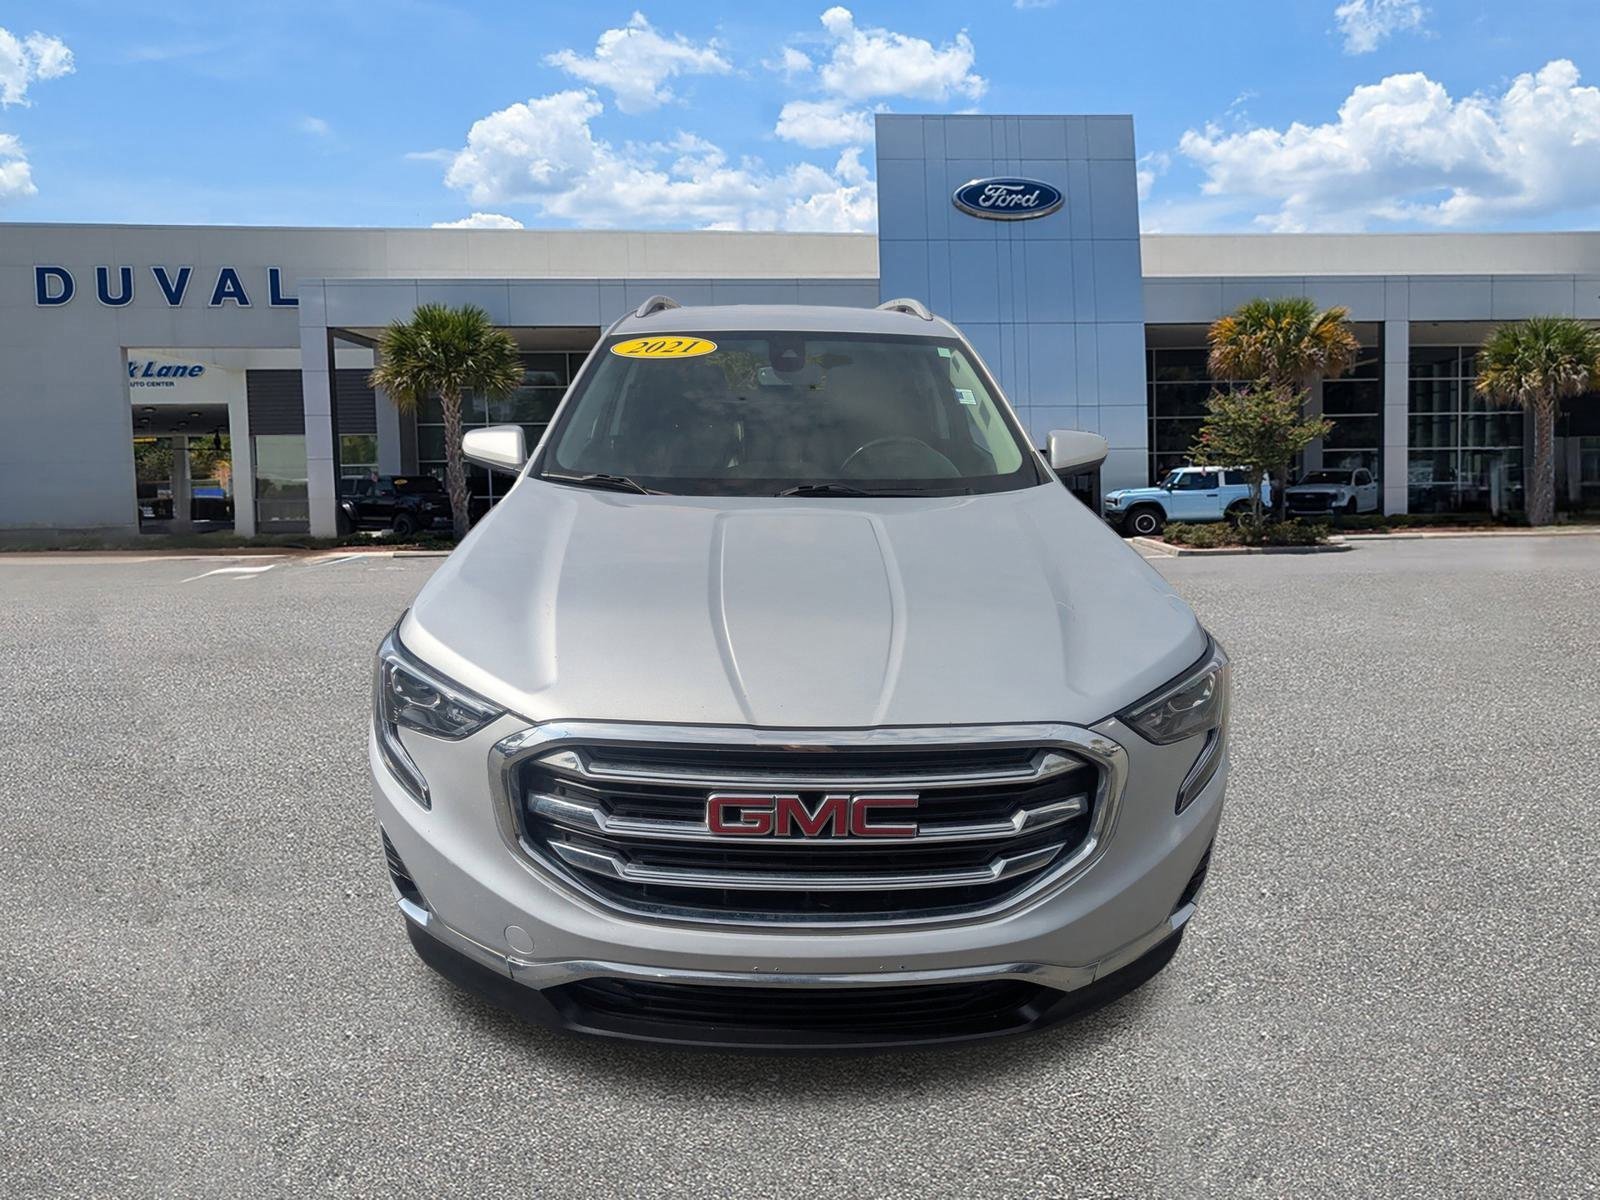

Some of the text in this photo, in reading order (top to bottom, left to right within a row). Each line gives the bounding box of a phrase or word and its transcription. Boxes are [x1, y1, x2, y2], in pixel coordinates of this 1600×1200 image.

[979, 184, 1040, 207] Ford
[34, 265, 299, 307] DUVAL
[625, 341, 700, 354] 2021
[141, 361, 204, 378] Lane
[705, 794, 919, 837] GMC
